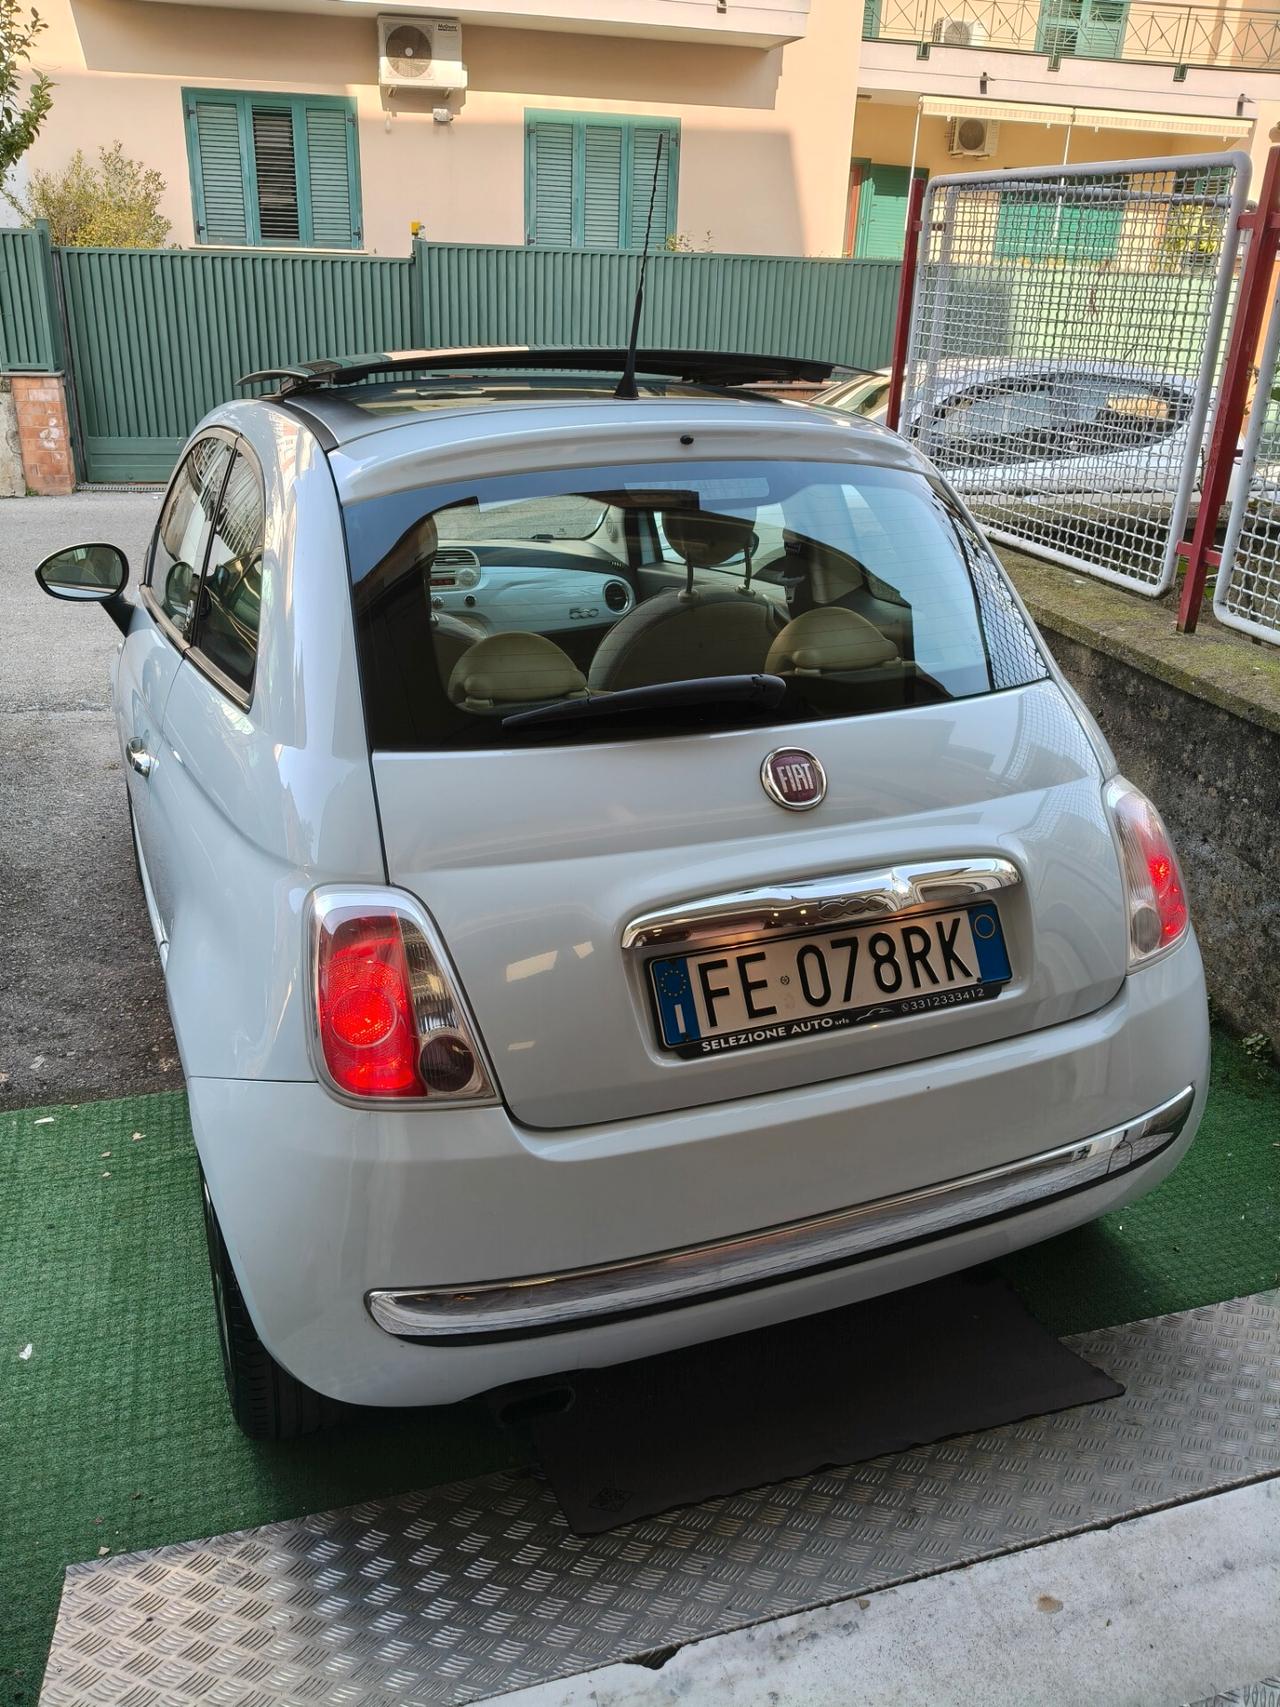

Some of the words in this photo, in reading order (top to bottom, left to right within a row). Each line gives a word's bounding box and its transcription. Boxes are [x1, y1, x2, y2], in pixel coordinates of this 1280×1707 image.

[776, 763, 814, 793] FIAT
[698, 952, 777, 1028] FE
[796, 917, 973, 1007] 078RK
[701, 1026, 787, 1052] SELEZIONE
[791, 1017, 833, 1034] AUTO
